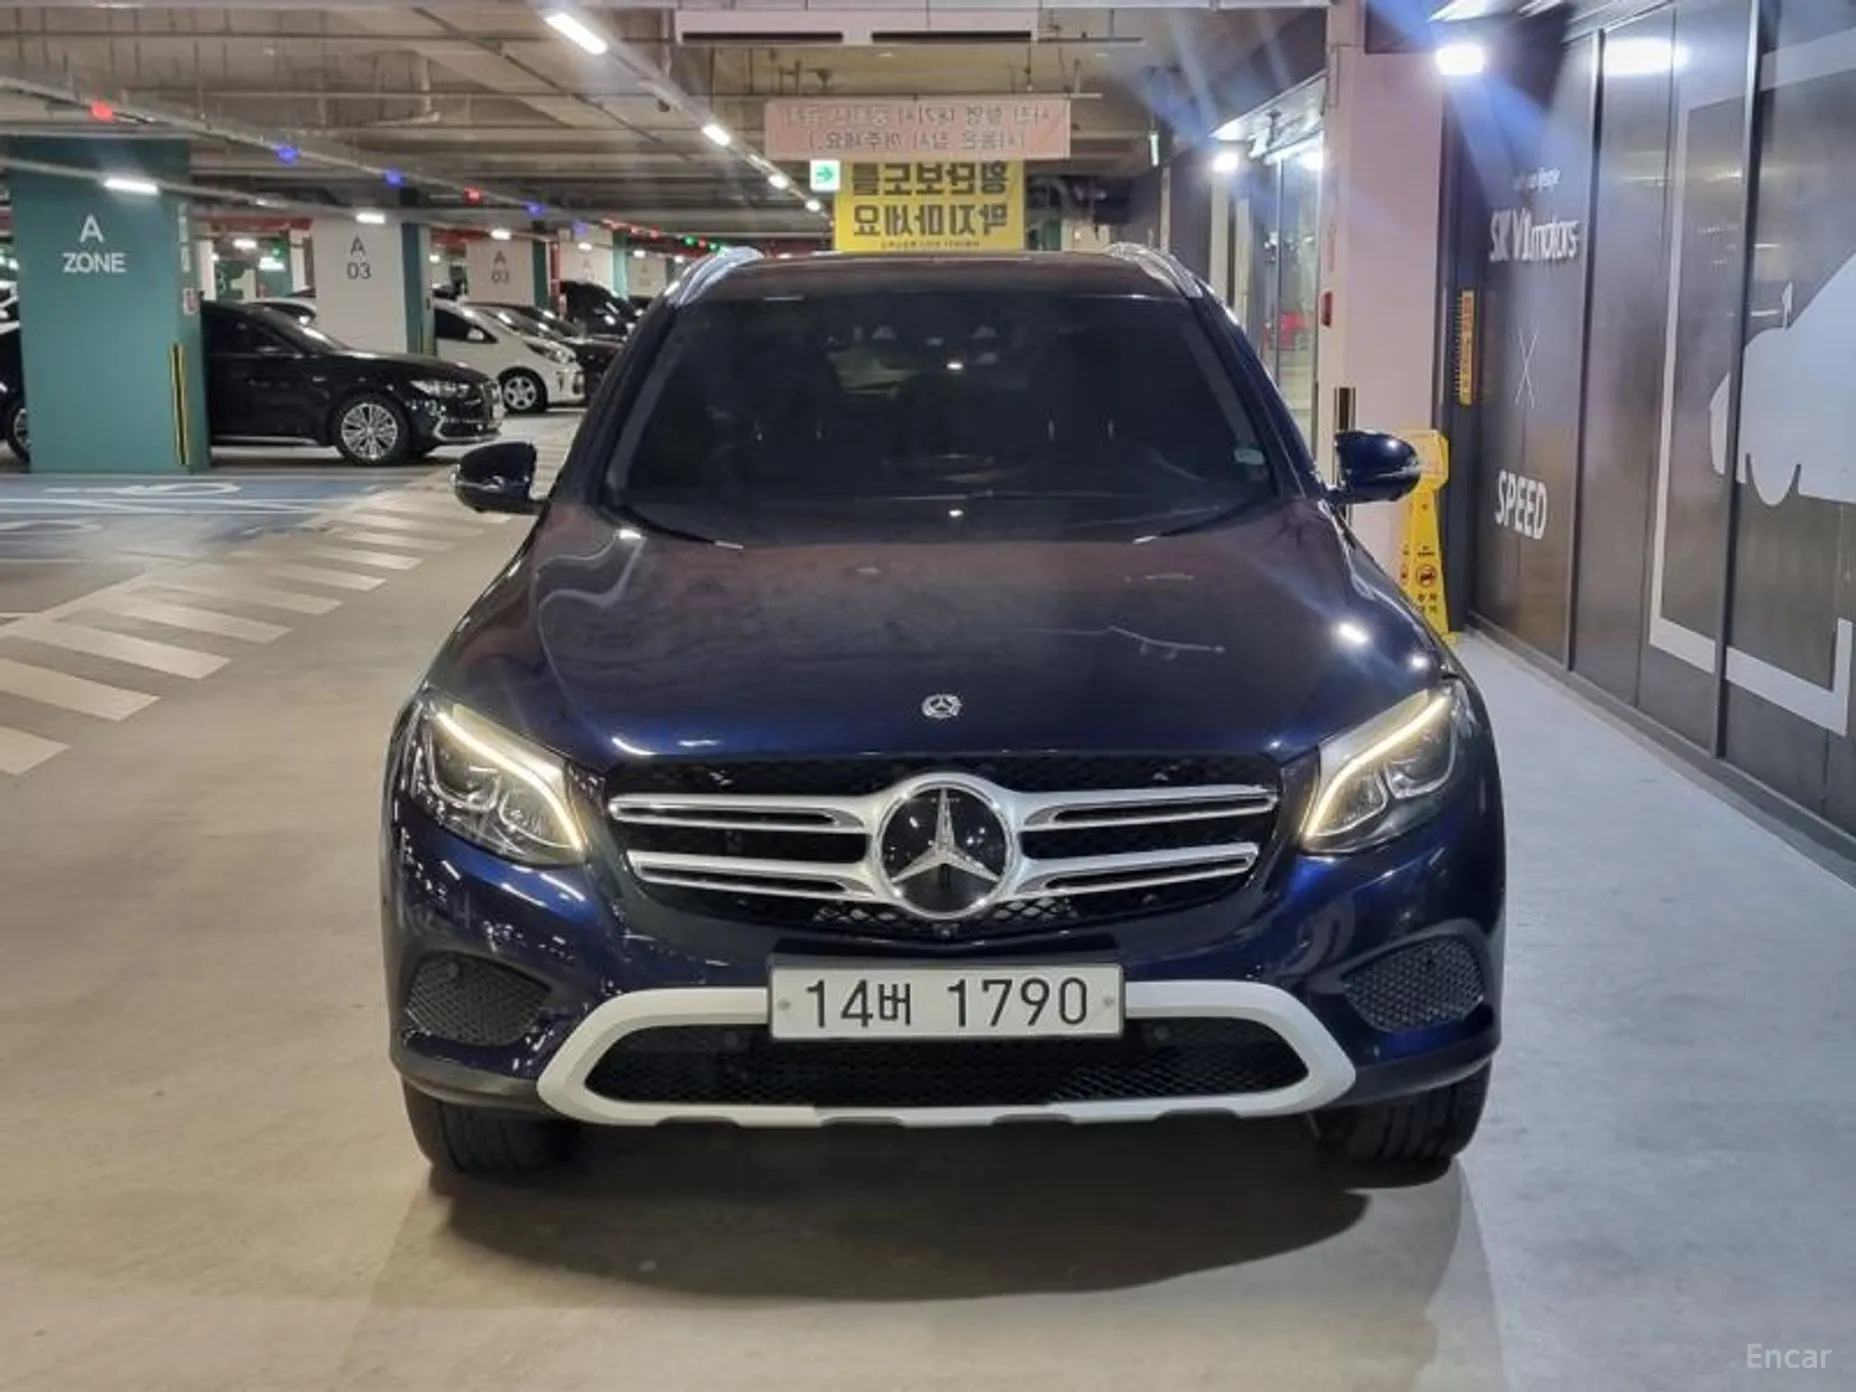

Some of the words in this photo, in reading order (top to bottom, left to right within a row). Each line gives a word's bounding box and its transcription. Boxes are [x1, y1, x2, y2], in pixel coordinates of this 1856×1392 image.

[79, 213, 104, 243] A
[350, 236, 366, 255] A
[62, 252, 127, 273] ZONE
[346, 262, 372, 280] 03
[1495, 469, 1548, 540] SPEED
[805, 979, 912, 1028] 14버
[946, 977, 1088, 1027] 1790
